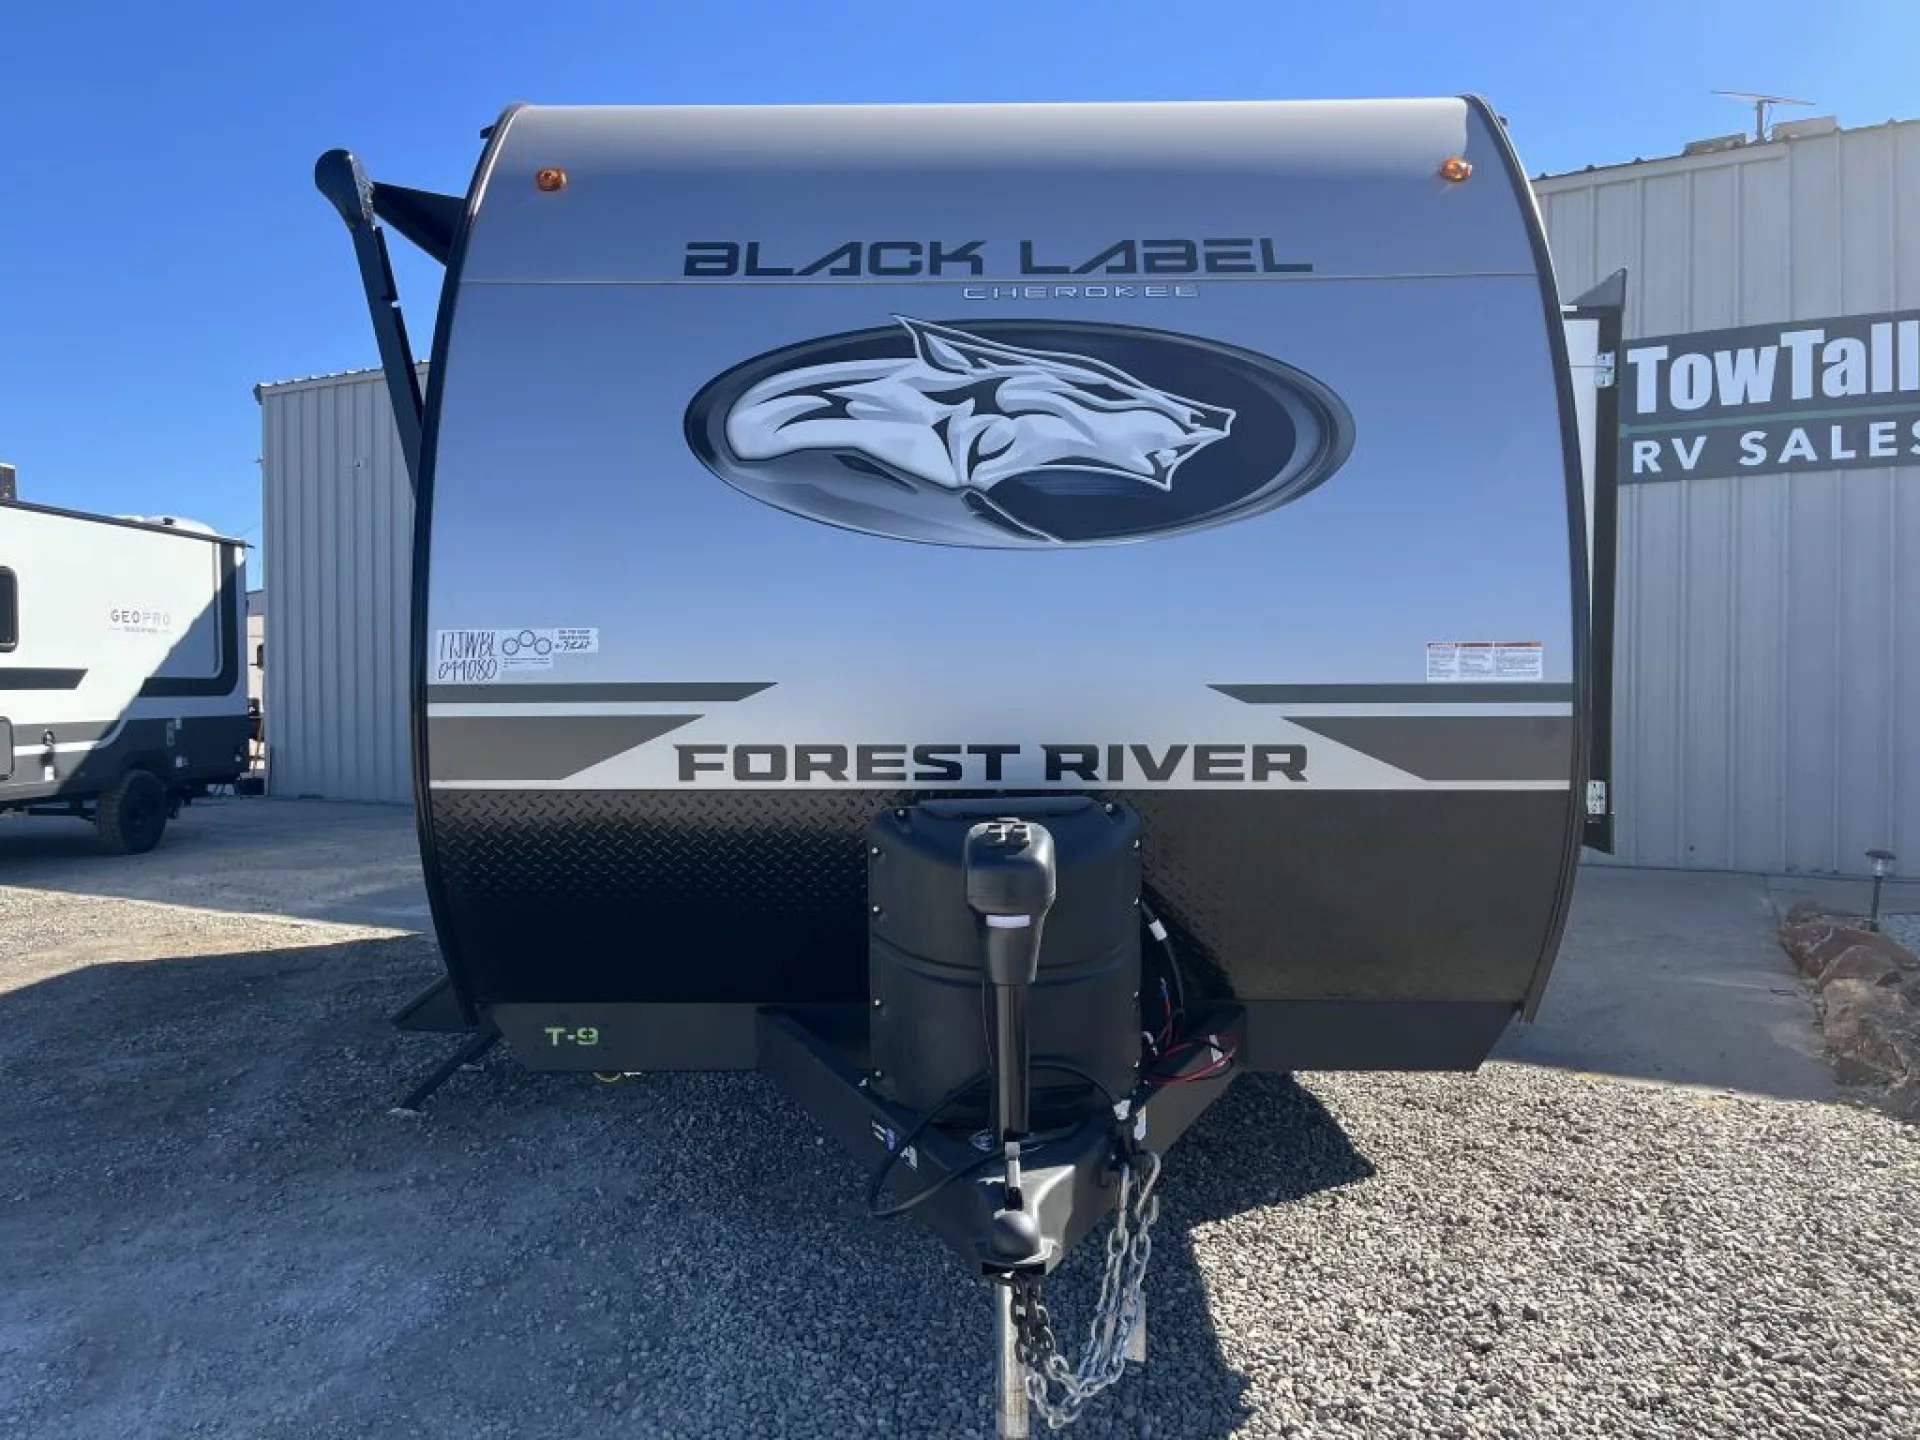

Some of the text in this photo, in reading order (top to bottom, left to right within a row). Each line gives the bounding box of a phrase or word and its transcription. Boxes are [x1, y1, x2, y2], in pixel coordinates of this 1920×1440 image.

[684, 237, 1314, 276] BLACK LABEL
[963, 286, 1200, 299] CHEROKEE
[1632, 435, 1707, 474] RV
[674, 744, 1309, 782] FOREST RIVER
[544, 1026, 599, 1047] T-9
